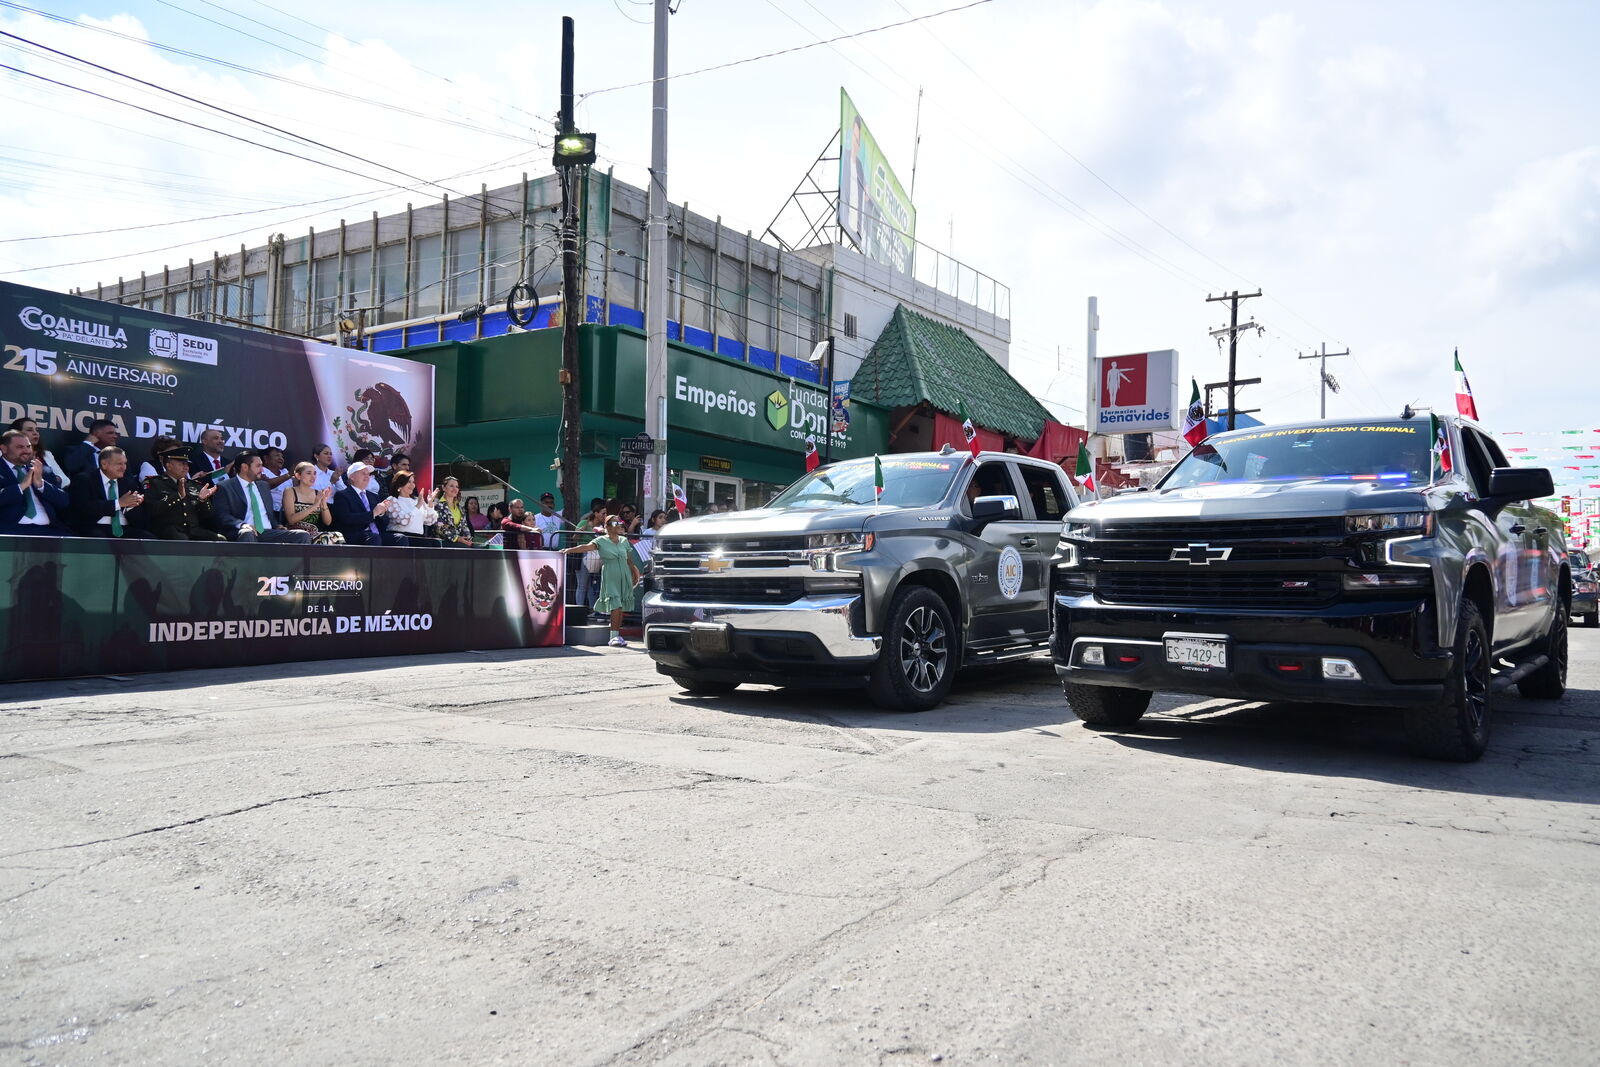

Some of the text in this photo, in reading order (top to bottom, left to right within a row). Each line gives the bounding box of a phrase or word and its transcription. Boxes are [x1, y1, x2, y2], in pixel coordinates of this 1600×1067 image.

[18, 306, 127, 341] COAHUILA
[75, 335, 110, 347] DELANTE
[182, 339, 212, 351] SEDU
[3, 345, 178, 388] 215 ANIVERSARIO
[88, 395, 131, 409] DE LA
[675, 375, 757, 417] Empeños
[1100, 408, 1170, 424] benavides
[135, 416, 176, 438] DE
[1275, 426, 1359, 436] INVESTIGACION
[1359, 426, 1417, 434] CRIMINAL
[816, 435, 834, 447] DESE
[834, 439, 847, 449] 1919
[1005, 564, 1017, 577] AIC
[256, 575, 363, 596] 215 ANIVERSARIO
[307, 605, 335, 613] DE LA
[148, 609, 433, 643] INDEPENDENCIA DE MÉXICO
[1166, 645, 1225, 665] ES-7429-C
[1181, 665, 1209, 673] CHEVROLET
